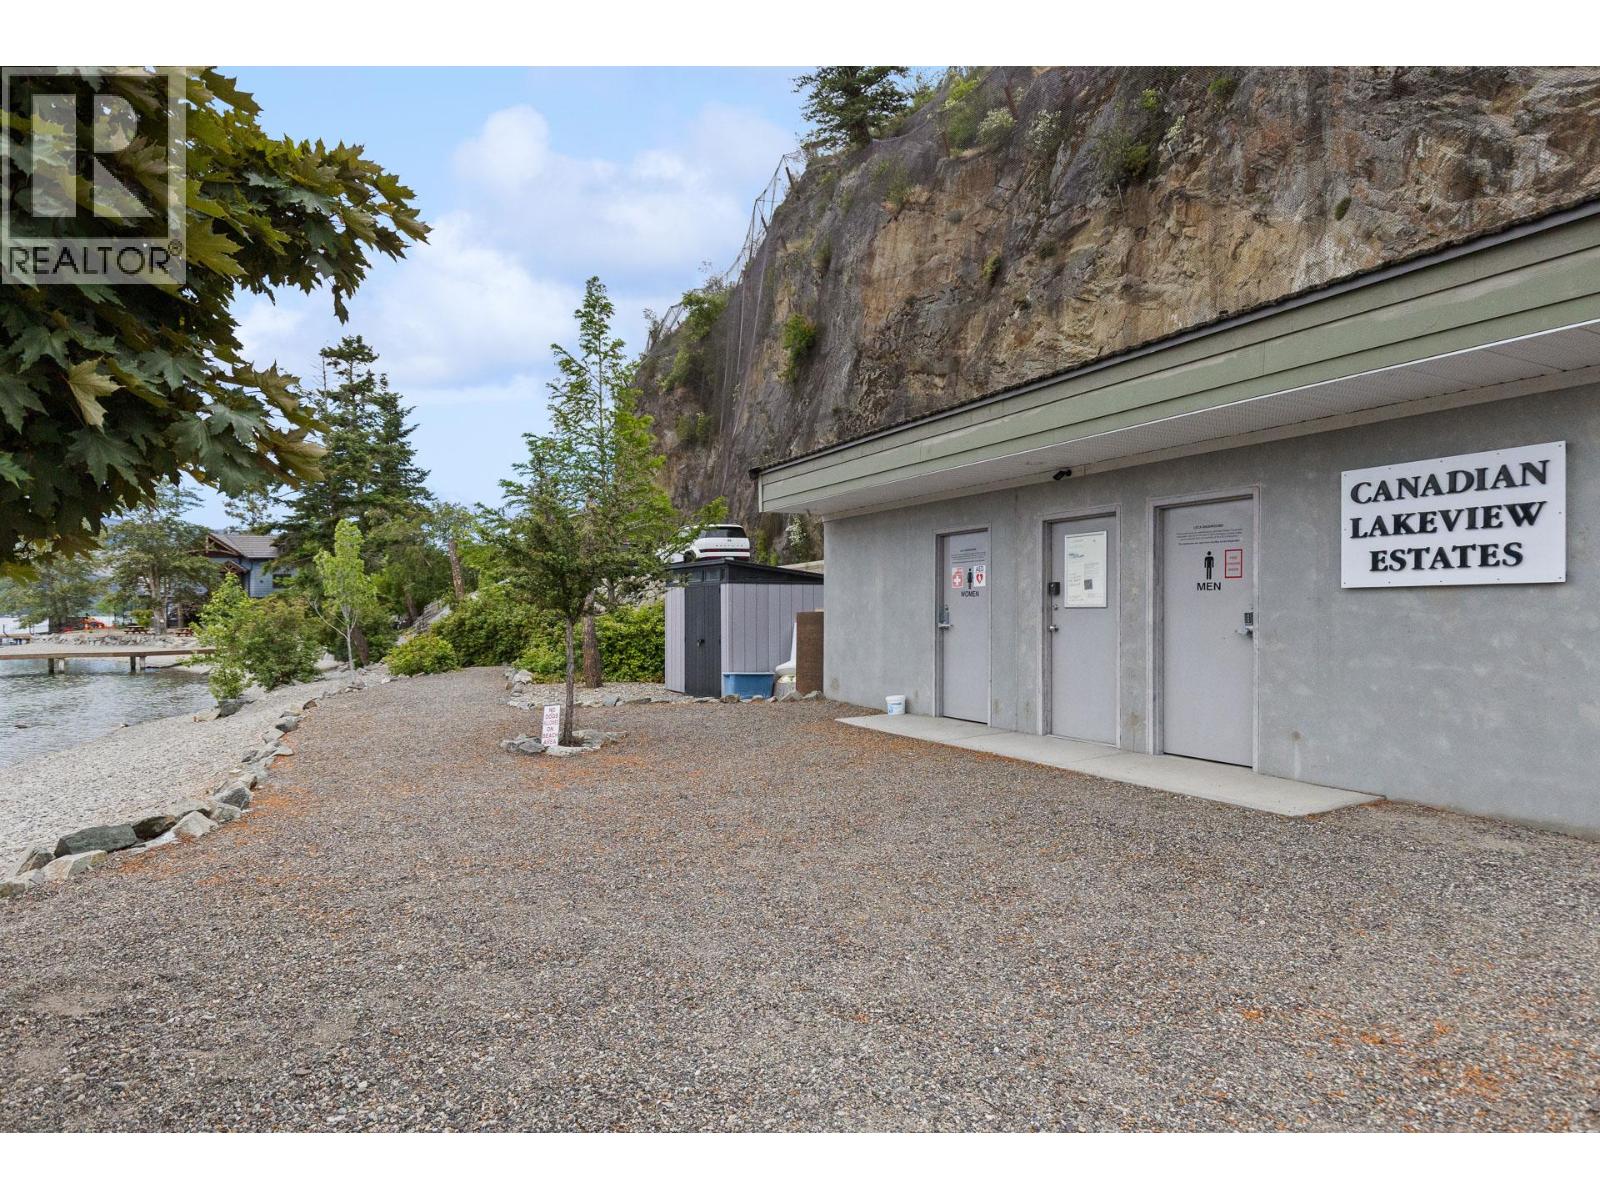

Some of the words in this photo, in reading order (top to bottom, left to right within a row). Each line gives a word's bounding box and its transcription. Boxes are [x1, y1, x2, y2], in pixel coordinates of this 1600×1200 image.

[1350, 459, 1550, 504] CANADIAN
[1350, 501, 1547, 538] LAKEVIEW
[1369, 542, 1524, 571] ESTATES
[1196, 582, 1222, 591] MEN
